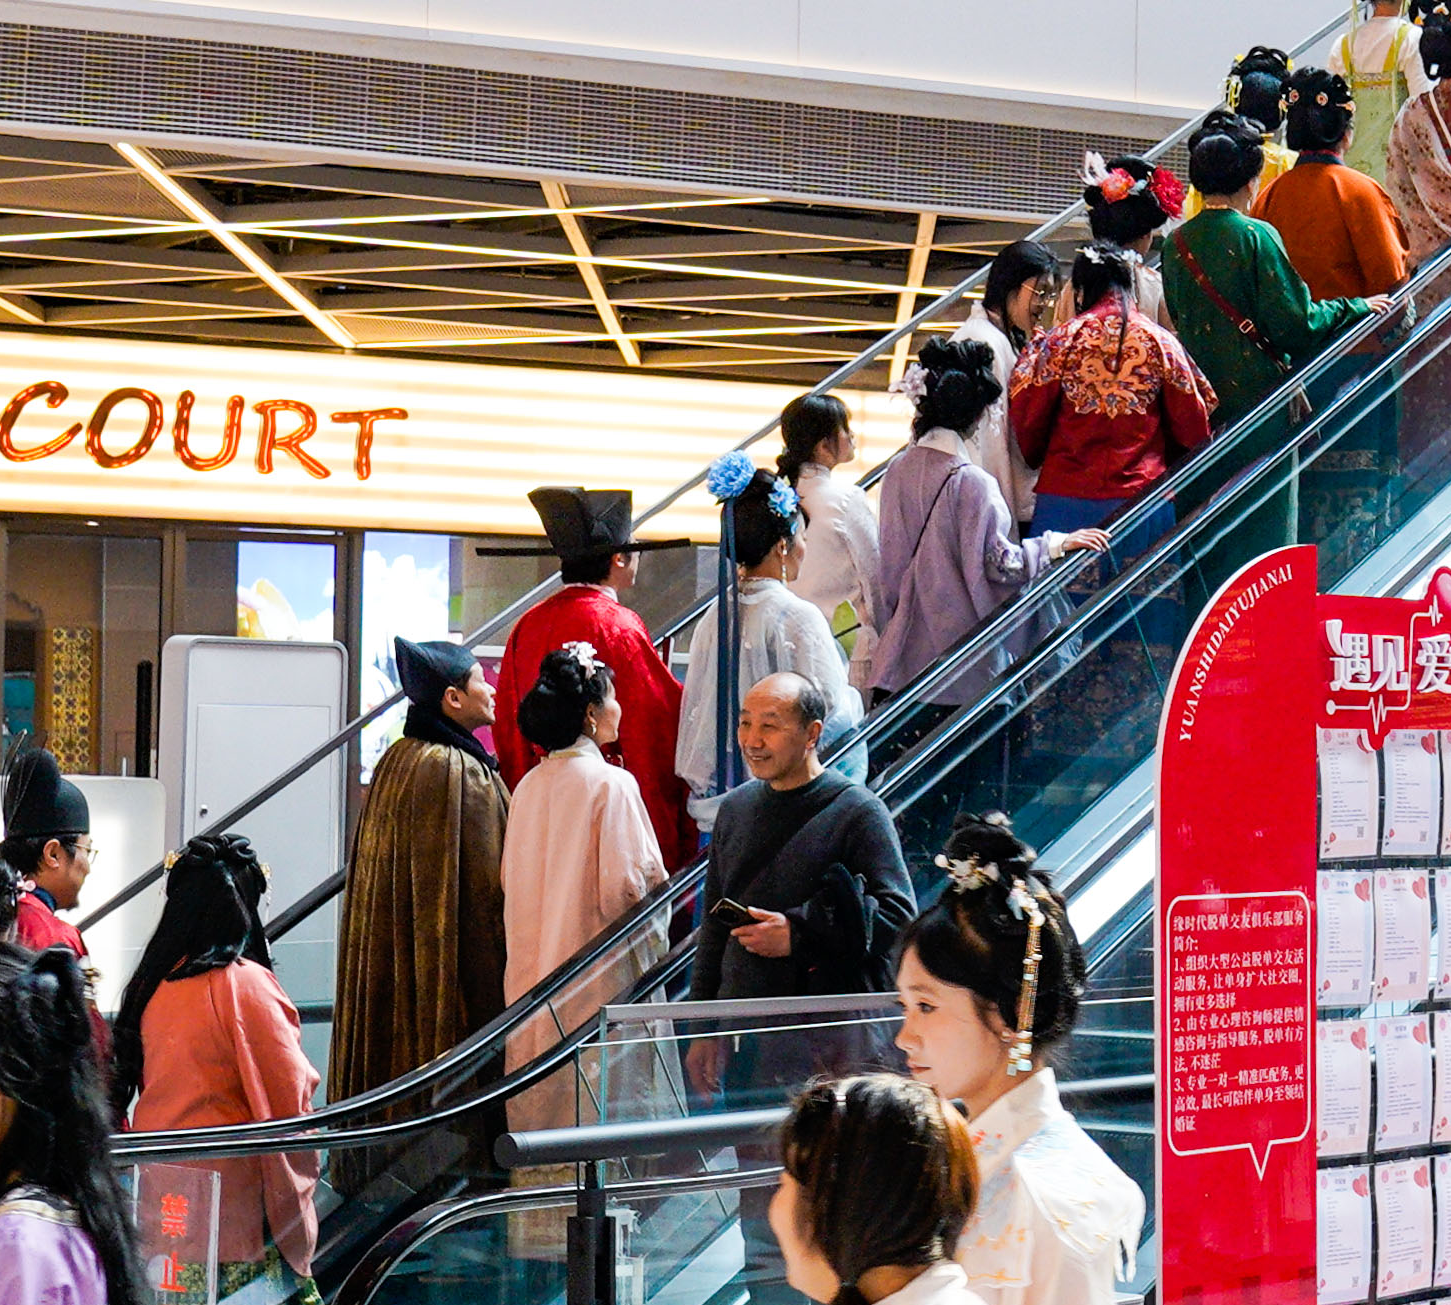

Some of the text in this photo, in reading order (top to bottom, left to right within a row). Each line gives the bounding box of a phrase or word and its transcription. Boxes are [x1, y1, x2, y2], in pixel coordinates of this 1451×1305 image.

[1173, 910, 1304, 933] 缘时代脱单交友俱乐部服务
[1173, 948, 1305, 972] 1、组织大型公益脱单交友活
[1173, 993, 1237, 1013] 拥有更多选择
[1173, 1006, 1305, 1033] 2、由专业心理咨询师提供情
[1173, 1114, 1197, 1133] 婚证
